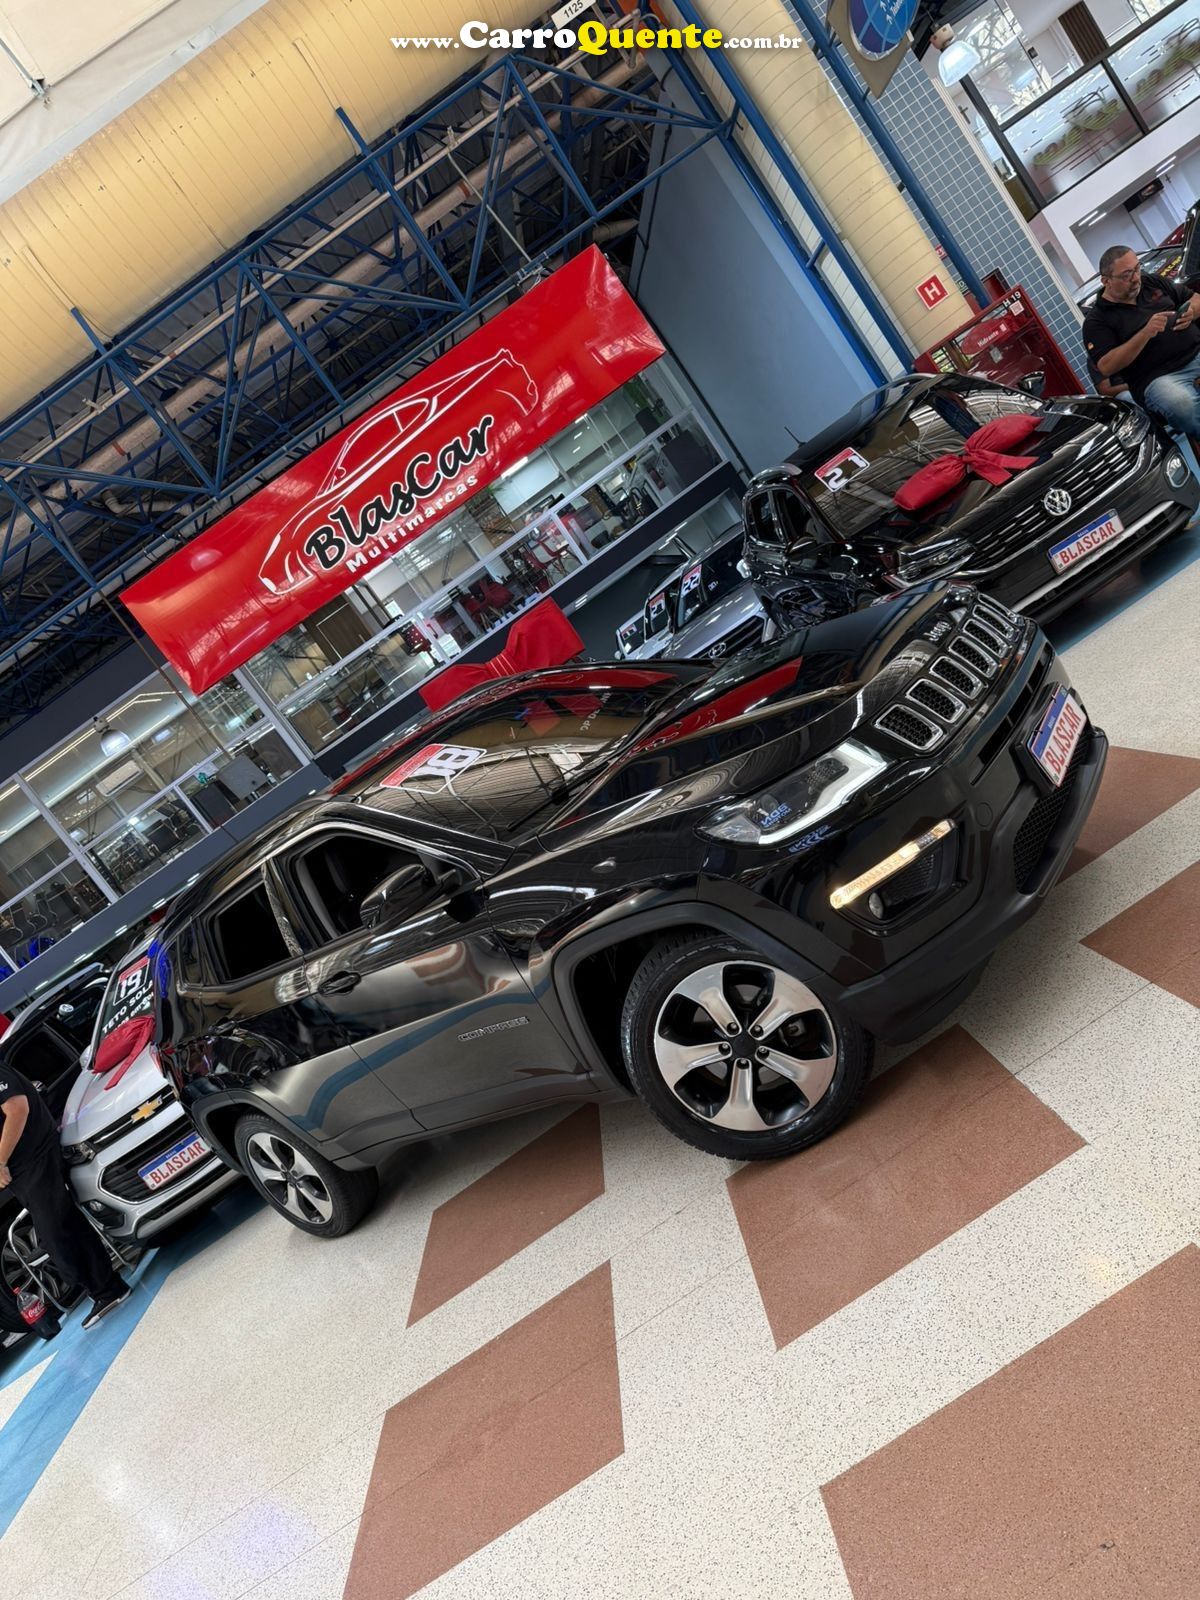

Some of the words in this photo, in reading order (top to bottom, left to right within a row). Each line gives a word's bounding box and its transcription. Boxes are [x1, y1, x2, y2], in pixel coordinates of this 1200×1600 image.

[564, 0, 584, 18] 1125
[923, 281, 941, 301] H
[1010, 291, 1021, 302] 19
[977, 330, 999, 347] Hidrante
[824, 454, 867, 489] 21
[303, 414, 495, 571] BlasCar
[345, 474, 478, 574] Multimarcas
[1059, 521, 1116, 564] BLASCAR
[682, 573, 701, 597] 22
[923, 621, 951, 642] Jeep
[1044, 702, 1081, 774] BLASCAR
[408, 747, 481, 778] 18
[120, 969, 142, 998] 19
[102, 1006, 127, 1033] TETO
[457, 1016, 529, 1041] COMPASS
[149, 1141, 206, 1184] BLASCAR
